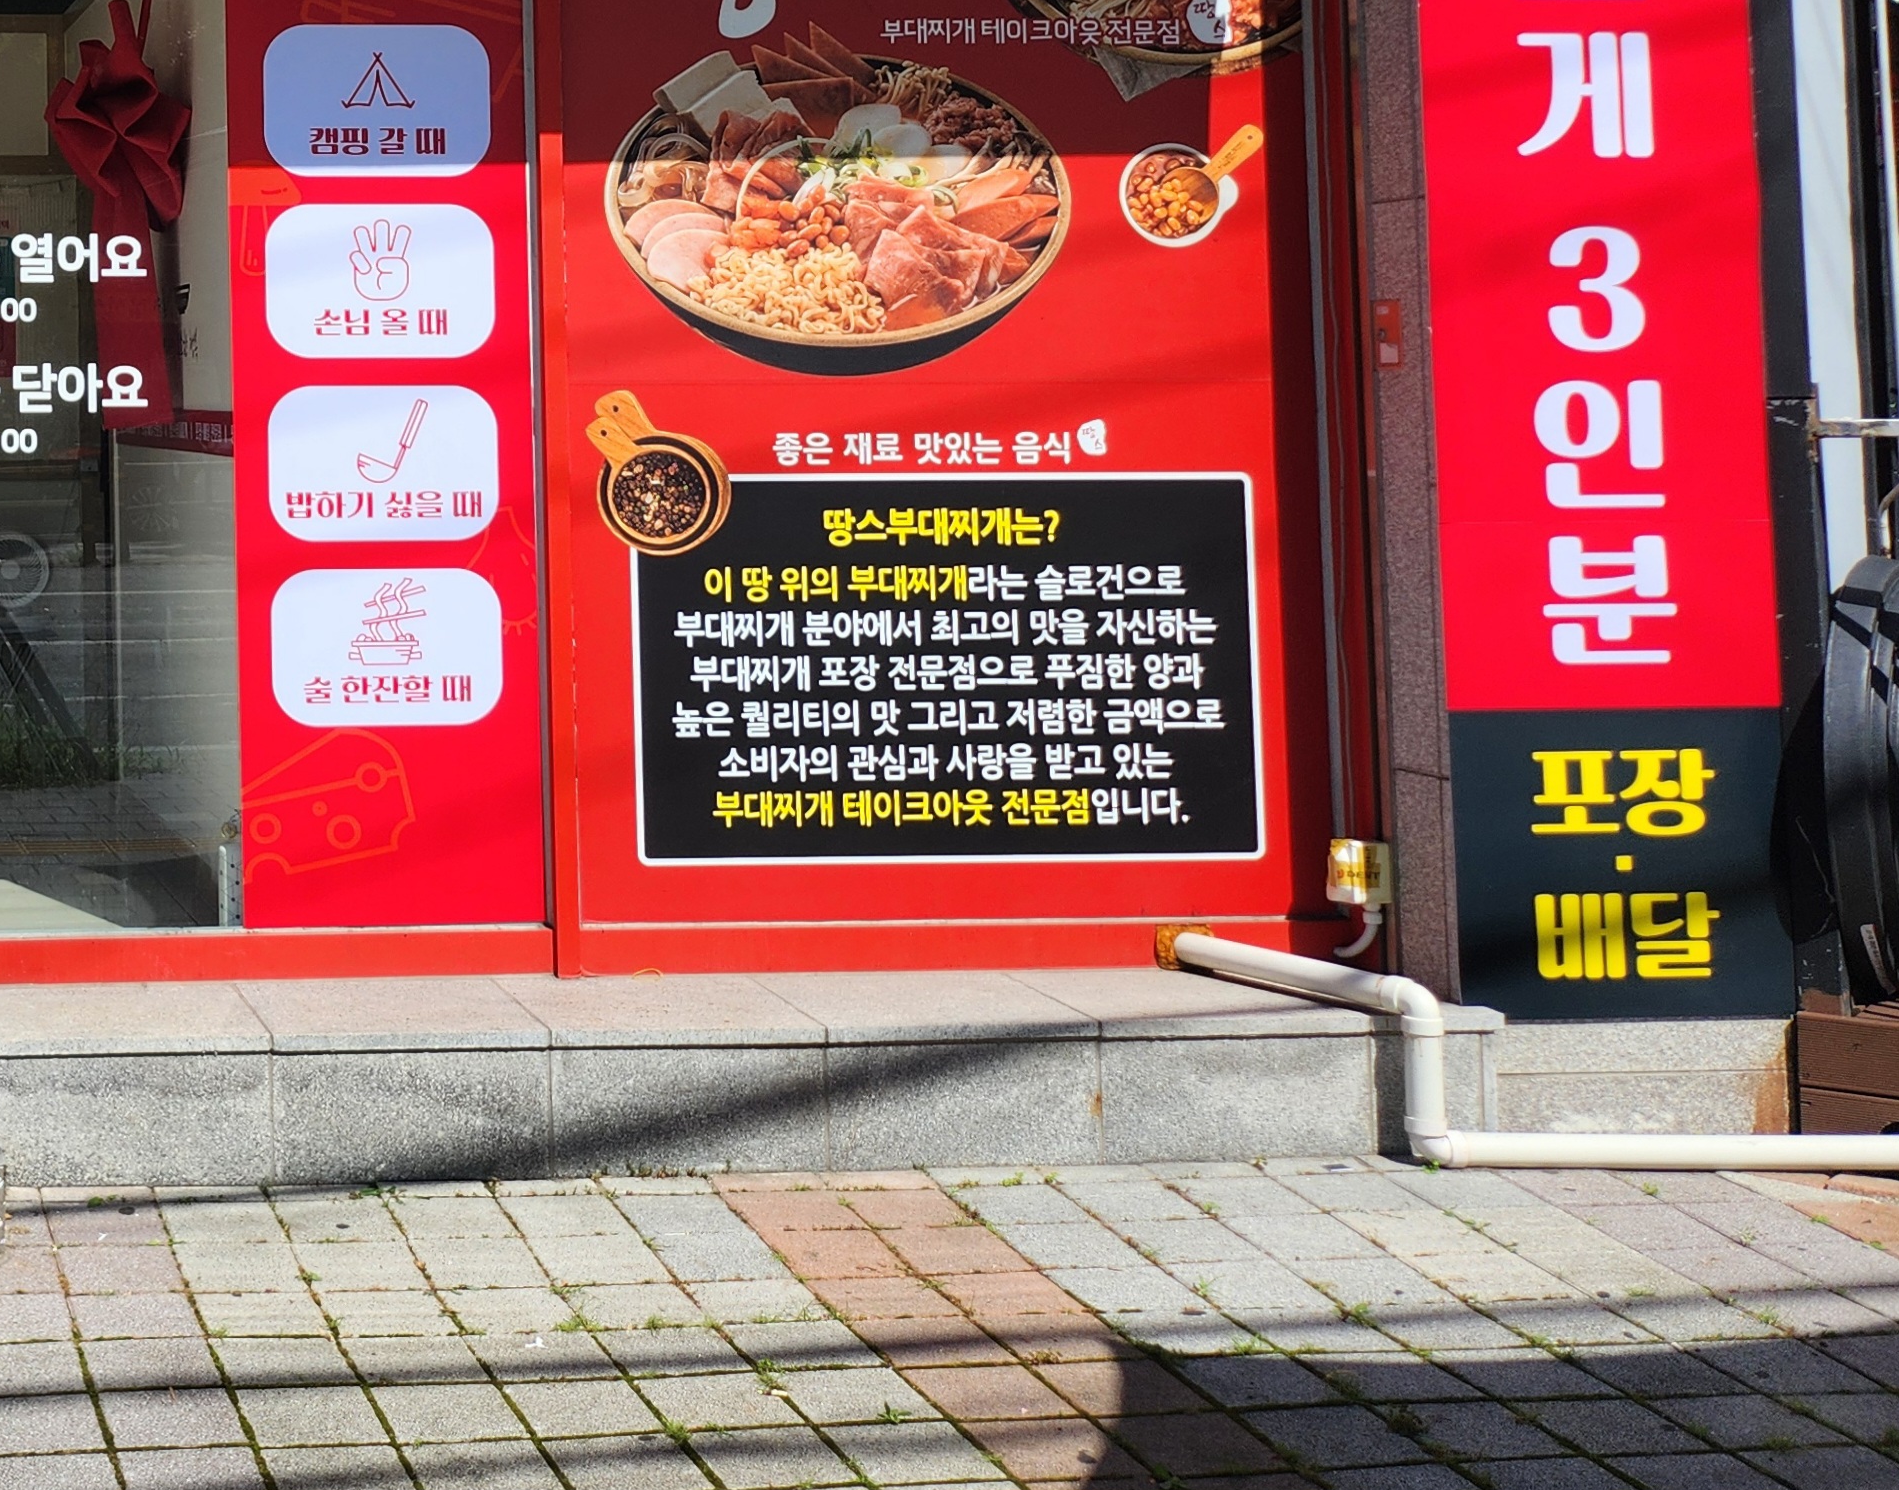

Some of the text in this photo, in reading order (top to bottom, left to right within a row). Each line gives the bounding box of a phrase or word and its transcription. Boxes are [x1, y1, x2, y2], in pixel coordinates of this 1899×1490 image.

[880, 18, 978, 46] 부대찌개
[981, 17, 1104, 47] 테이크아웃
[1107, 17, 1182, 45] 전문점
[309, 126, 447, 155] 캠핑 갈 때
[11, 232, 148, 283] 열어요
[313, 308, 448, 337] 손님 올 때
[11, 362, 149, 414] 닫아요
[772, 431, 1072, 466] 좋은 재료 맛있는 음식
[1532, 224, 1678, 666] 3인분
[285, 490, 483, 519] 밥하기 싫을 때
[822, 507, 1061, 548] 땅스부대찌개는?
[704, 565, 1187, 603] 이 땅 위의 부대찌개라는 슬로건으로
[673, 611, 1218, 650] 부대찌개 분야에서 최고의 맛을 자신하는
[303, 675, 472, 704] 술 한잔할 때
[690, 655, 1204, 693] 부대찌개 포장 전문점으로 푸짐한 양과
[671, 700, 1225, 739] 높은 퀄리티의 맛 그리고 저렴한 금액으로
[718, 744, 1173, 782] 소비자의 관심과 사랑을 받고 있는
[712, 790, 1191, 829] 부대찌개 테이크아웃 전문점입니다.
[1530, 748, 1718, 837] 포장
[1533, 890, 1721, 981] 배달
